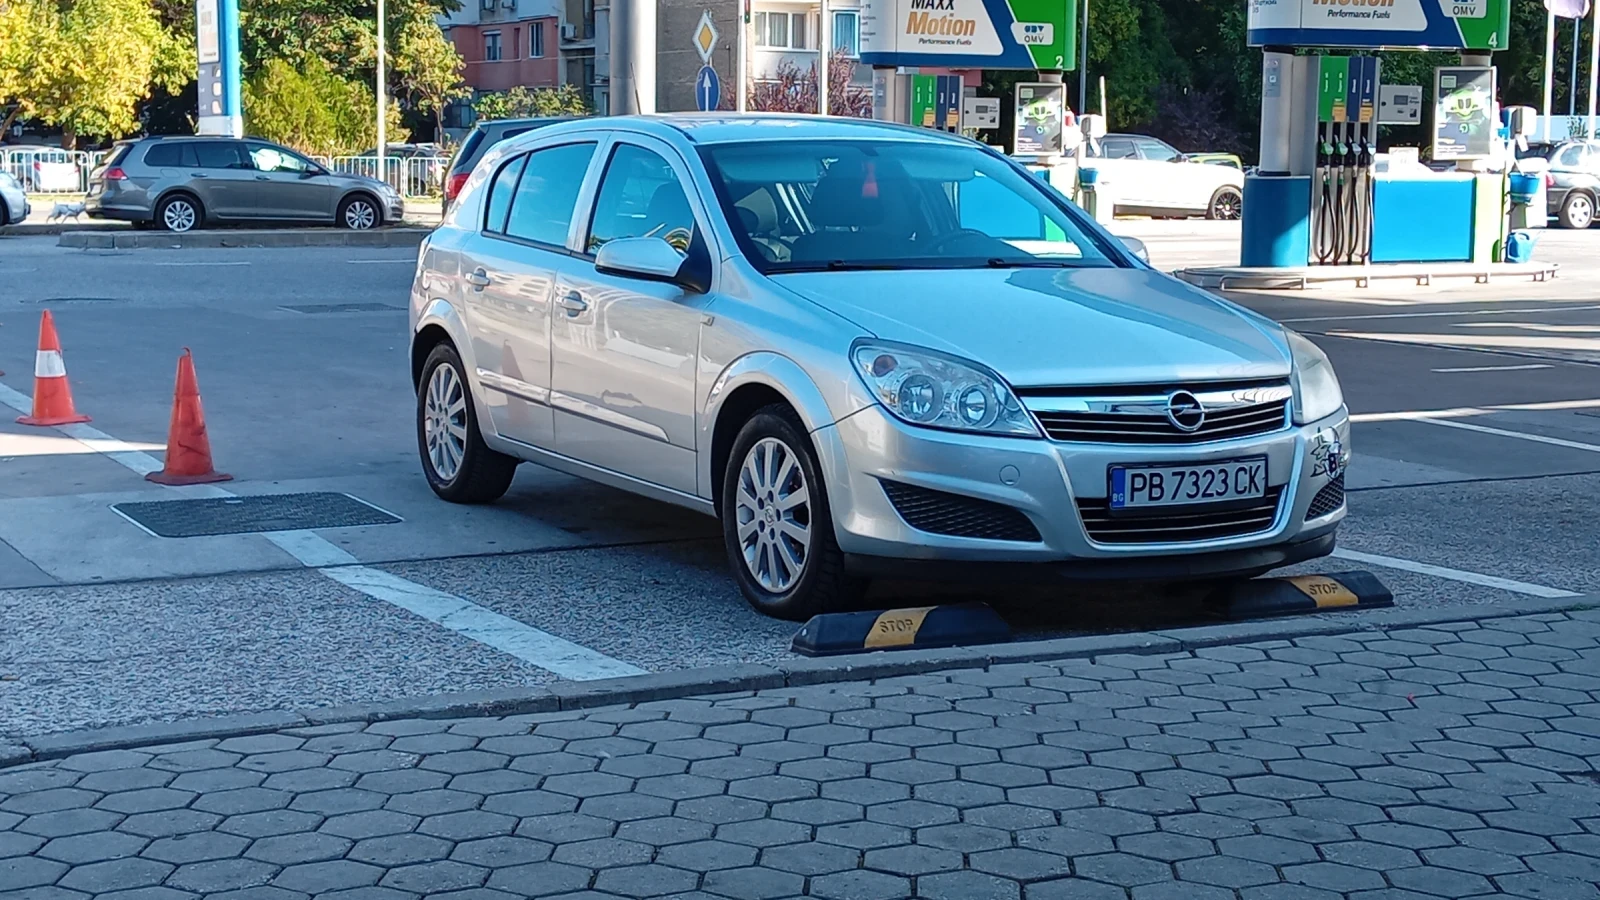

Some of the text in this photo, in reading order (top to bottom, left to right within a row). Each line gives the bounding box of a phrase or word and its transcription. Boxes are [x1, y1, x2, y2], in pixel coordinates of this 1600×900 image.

[1327, 9, 1391, 19] Performance Fuels
[1452, 5, 1476, 16] OMV
[906, 11, 976, 36] Motion
[1024, 35, 1044, 43] OMV
[1487, 31, 1498, 48] 4
[1055, 55, 1064, 69] 2
[1129, 464, 1261, 503] PB 7323 CK
[1112, 493, 1124, 503] BG
[1309, 583, 1339, 596] STOP
[879, 619, 914, 633] STOP
